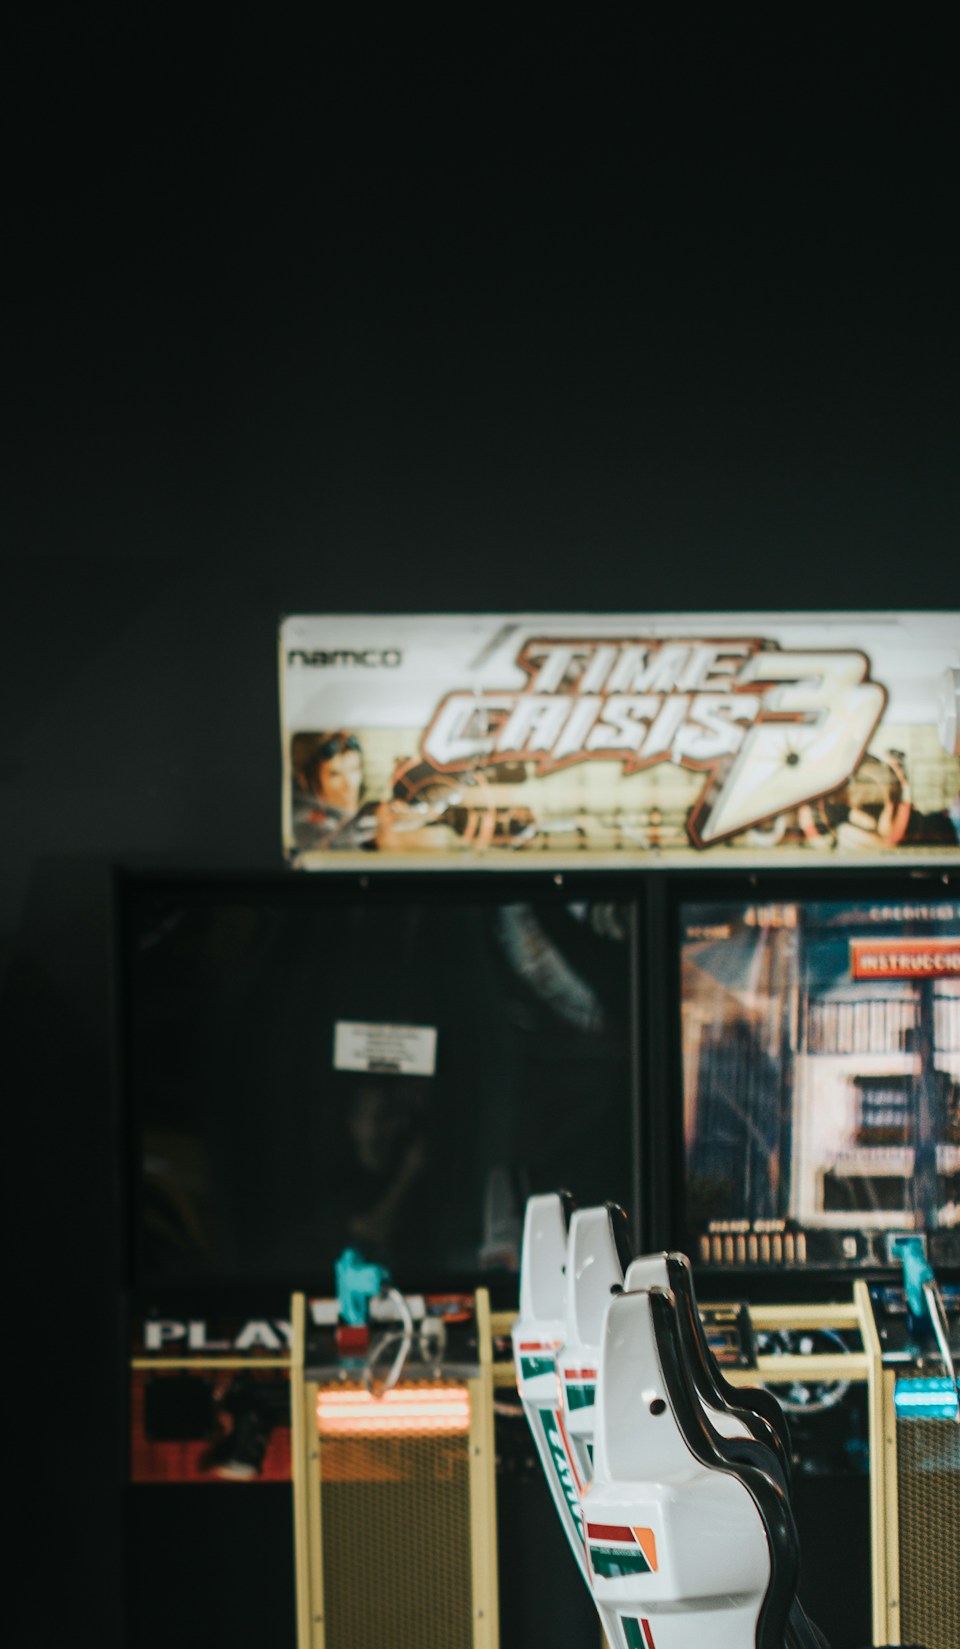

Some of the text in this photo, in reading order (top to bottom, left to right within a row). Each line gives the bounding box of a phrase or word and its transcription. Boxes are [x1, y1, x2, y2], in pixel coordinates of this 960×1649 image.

[288, 648, 402, 669] namco
[527, 641, 750, 693] TIME
[420, 648, 885, 846] CRISIS 3
